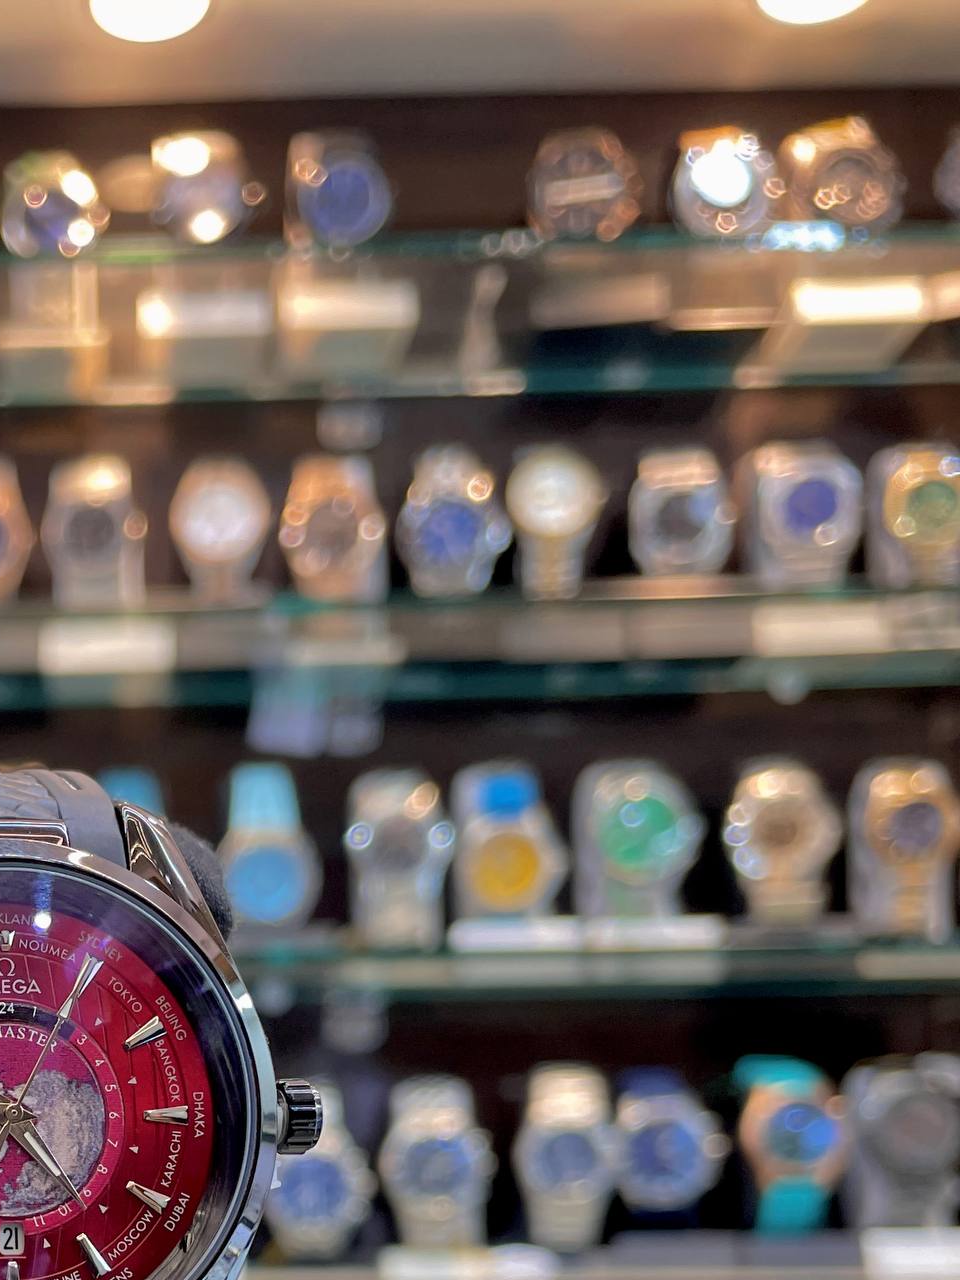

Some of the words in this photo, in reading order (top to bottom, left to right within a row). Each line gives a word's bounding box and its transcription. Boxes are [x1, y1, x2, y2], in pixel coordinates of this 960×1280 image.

[18, 938, 76, 962] NOUMEA
[107, 976, 143, 1013] TOKYO
[155, 994, 187, 1042] BEIJING
[76, 1034, 88, 1046] 3
[154, 1038, 181, 1102] BANGKOK
[104, 1083, 117, 1093] 5
[108, 1111, 120, 1120] 6
[192, 1091, 206, 1138] DHAKA
[106, 1138, 119, 1148] 7
[96, 1163, 108, 1175] 8
[160, 1130, 182, 1188] KARACHI
[32, 1216, 46, 1227] 11
[57, 1204, 73, 1217] 10
[163, 1192, 191, 1232] DUBAI
[2, 1226, 19, 1250] 21
[107, 1209, 154, 1261] MOSCOW
